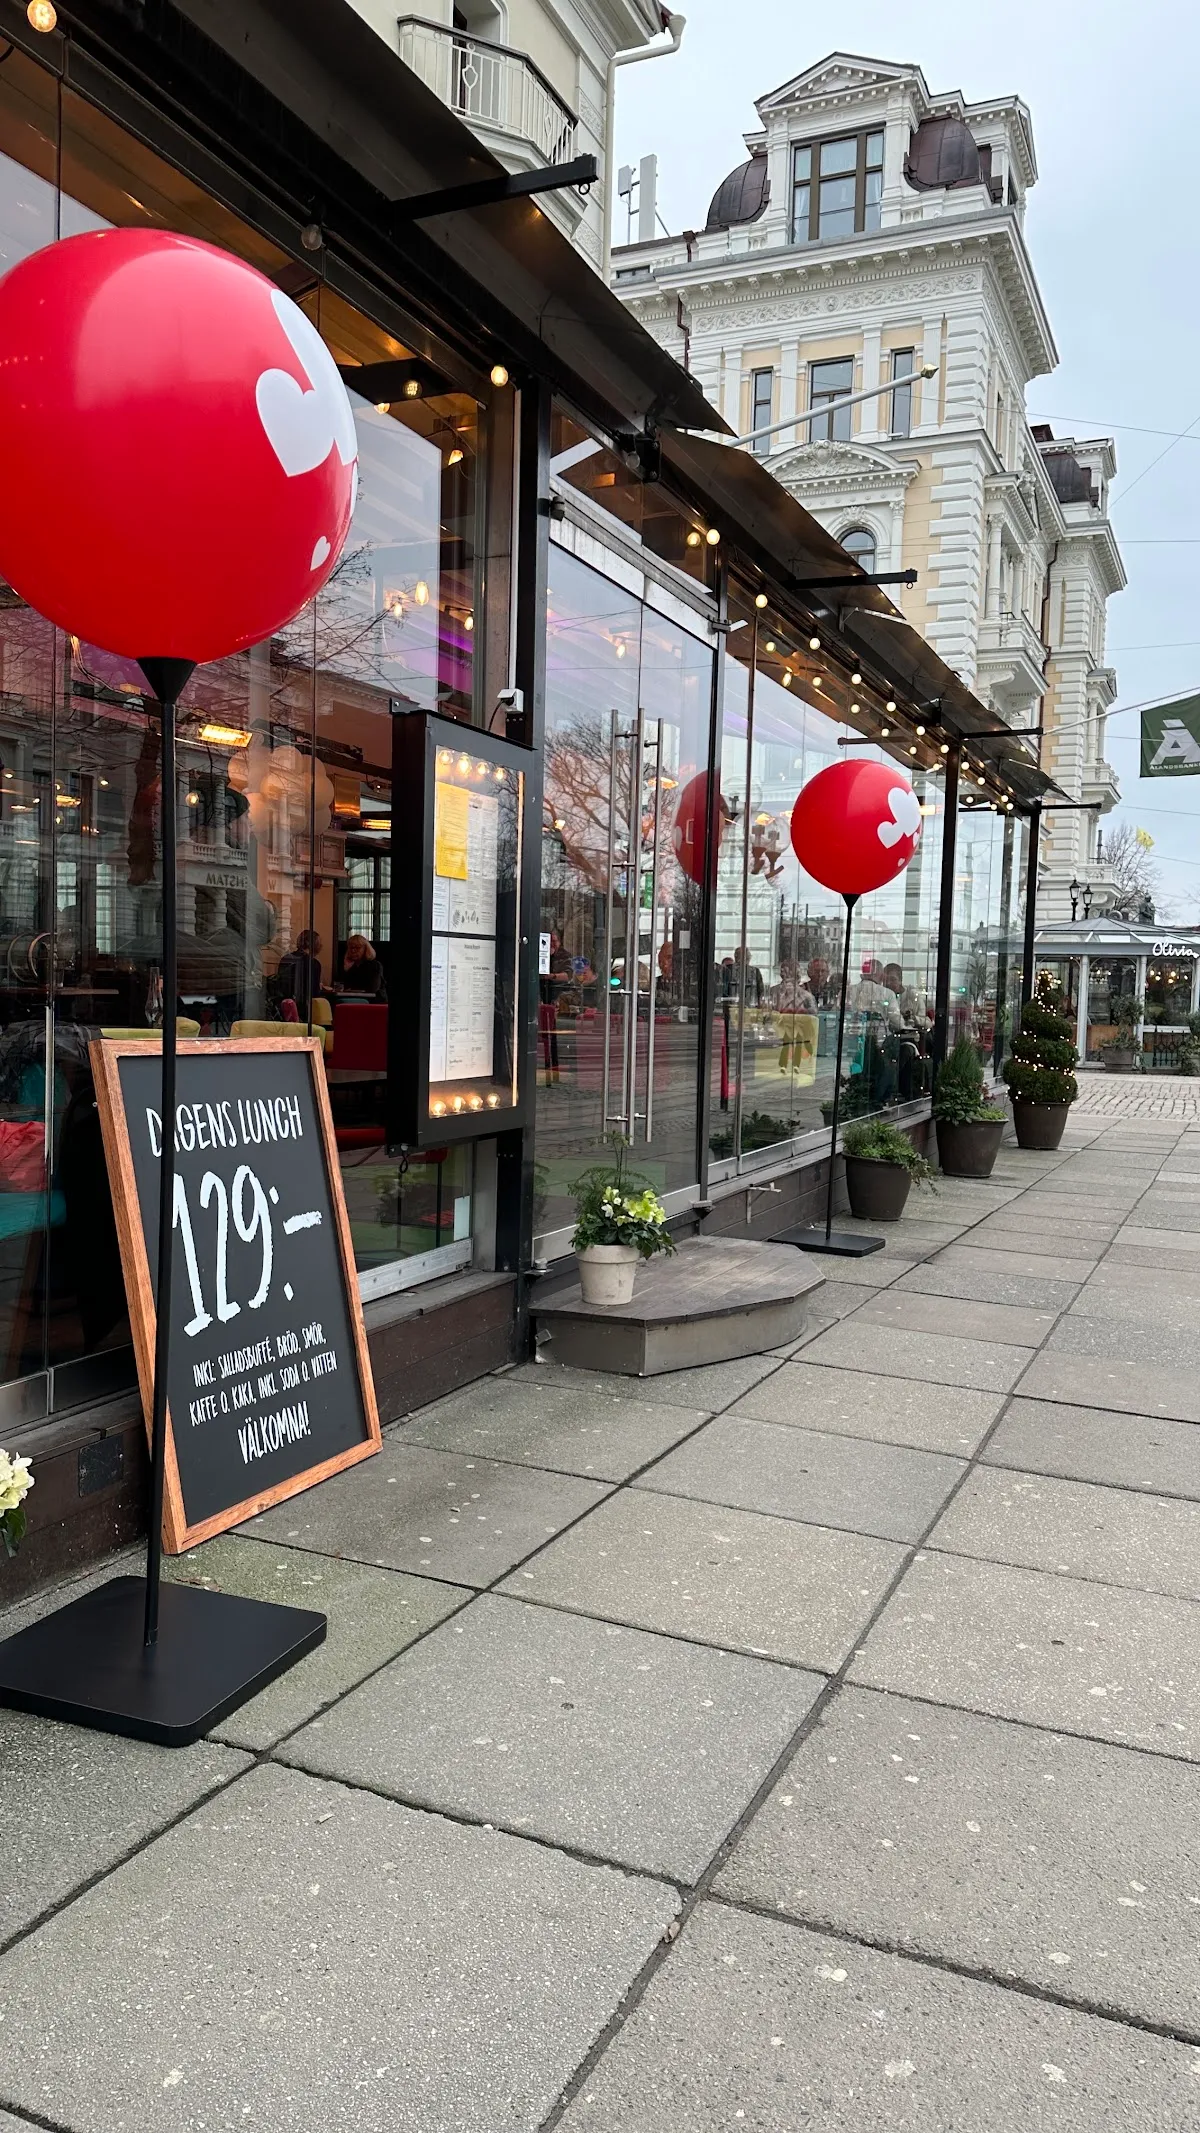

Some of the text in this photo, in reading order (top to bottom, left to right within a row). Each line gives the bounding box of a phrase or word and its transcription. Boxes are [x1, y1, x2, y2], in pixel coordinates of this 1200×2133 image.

[1152, 940, 1194, 957] Olivia
[146, 1095, 302, 1157] DGENS LUNCH
[276, 1330, 301, 1357] BRÖD,
[302, 1322, 326, 1349] SMÖR,
[189, 1351, 337, 1427] KAFFE O. KAKA, INKL. SODA O. VATTEN
[238, 1401, 311, 1464] VÄLKOMNA!
